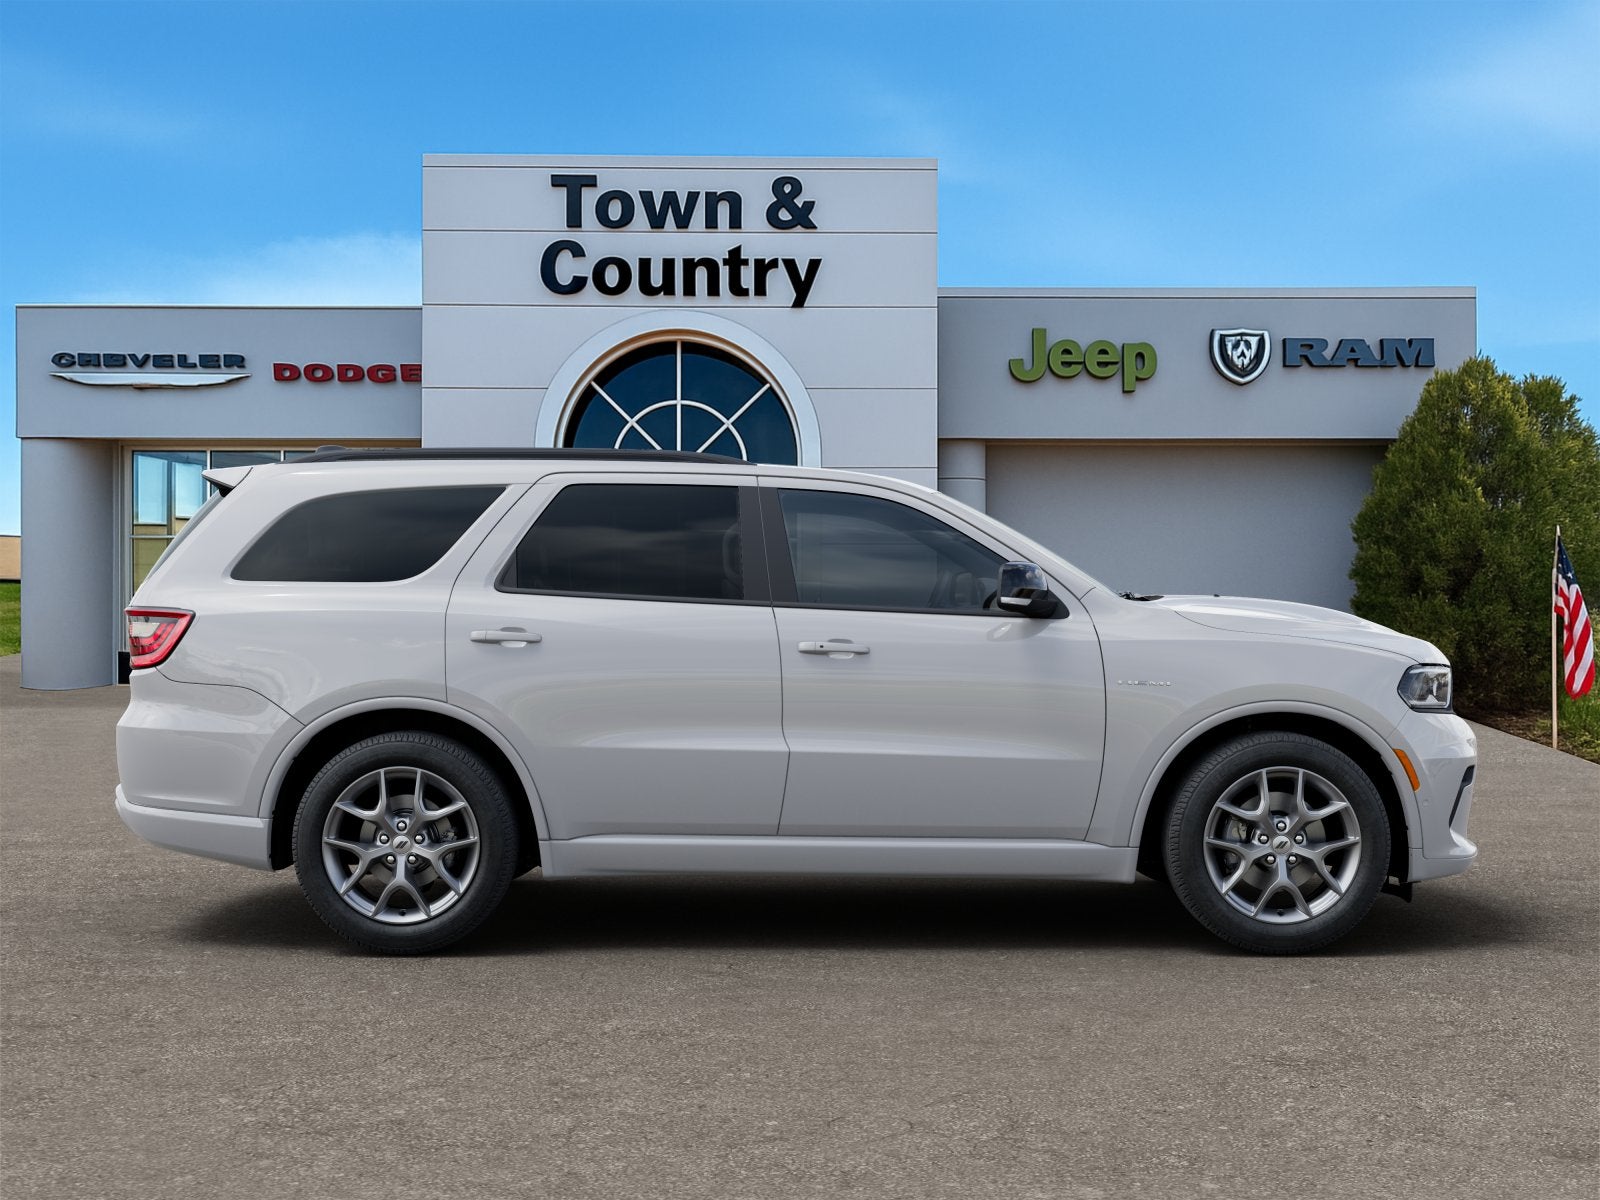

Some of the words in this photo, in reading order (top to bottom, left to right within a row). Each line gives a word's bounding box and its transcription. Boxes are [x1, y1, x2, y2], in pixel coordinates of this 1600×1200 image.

[550, 174, 742, 229] Town
[765, 175, 818, 230] &
[539, 239, 823, 308] Country
[273, 362, 422, 383] DODGE
[1009, 327, 1158, 393] Jeep
[1283, 337, 1436, 368] RAM
